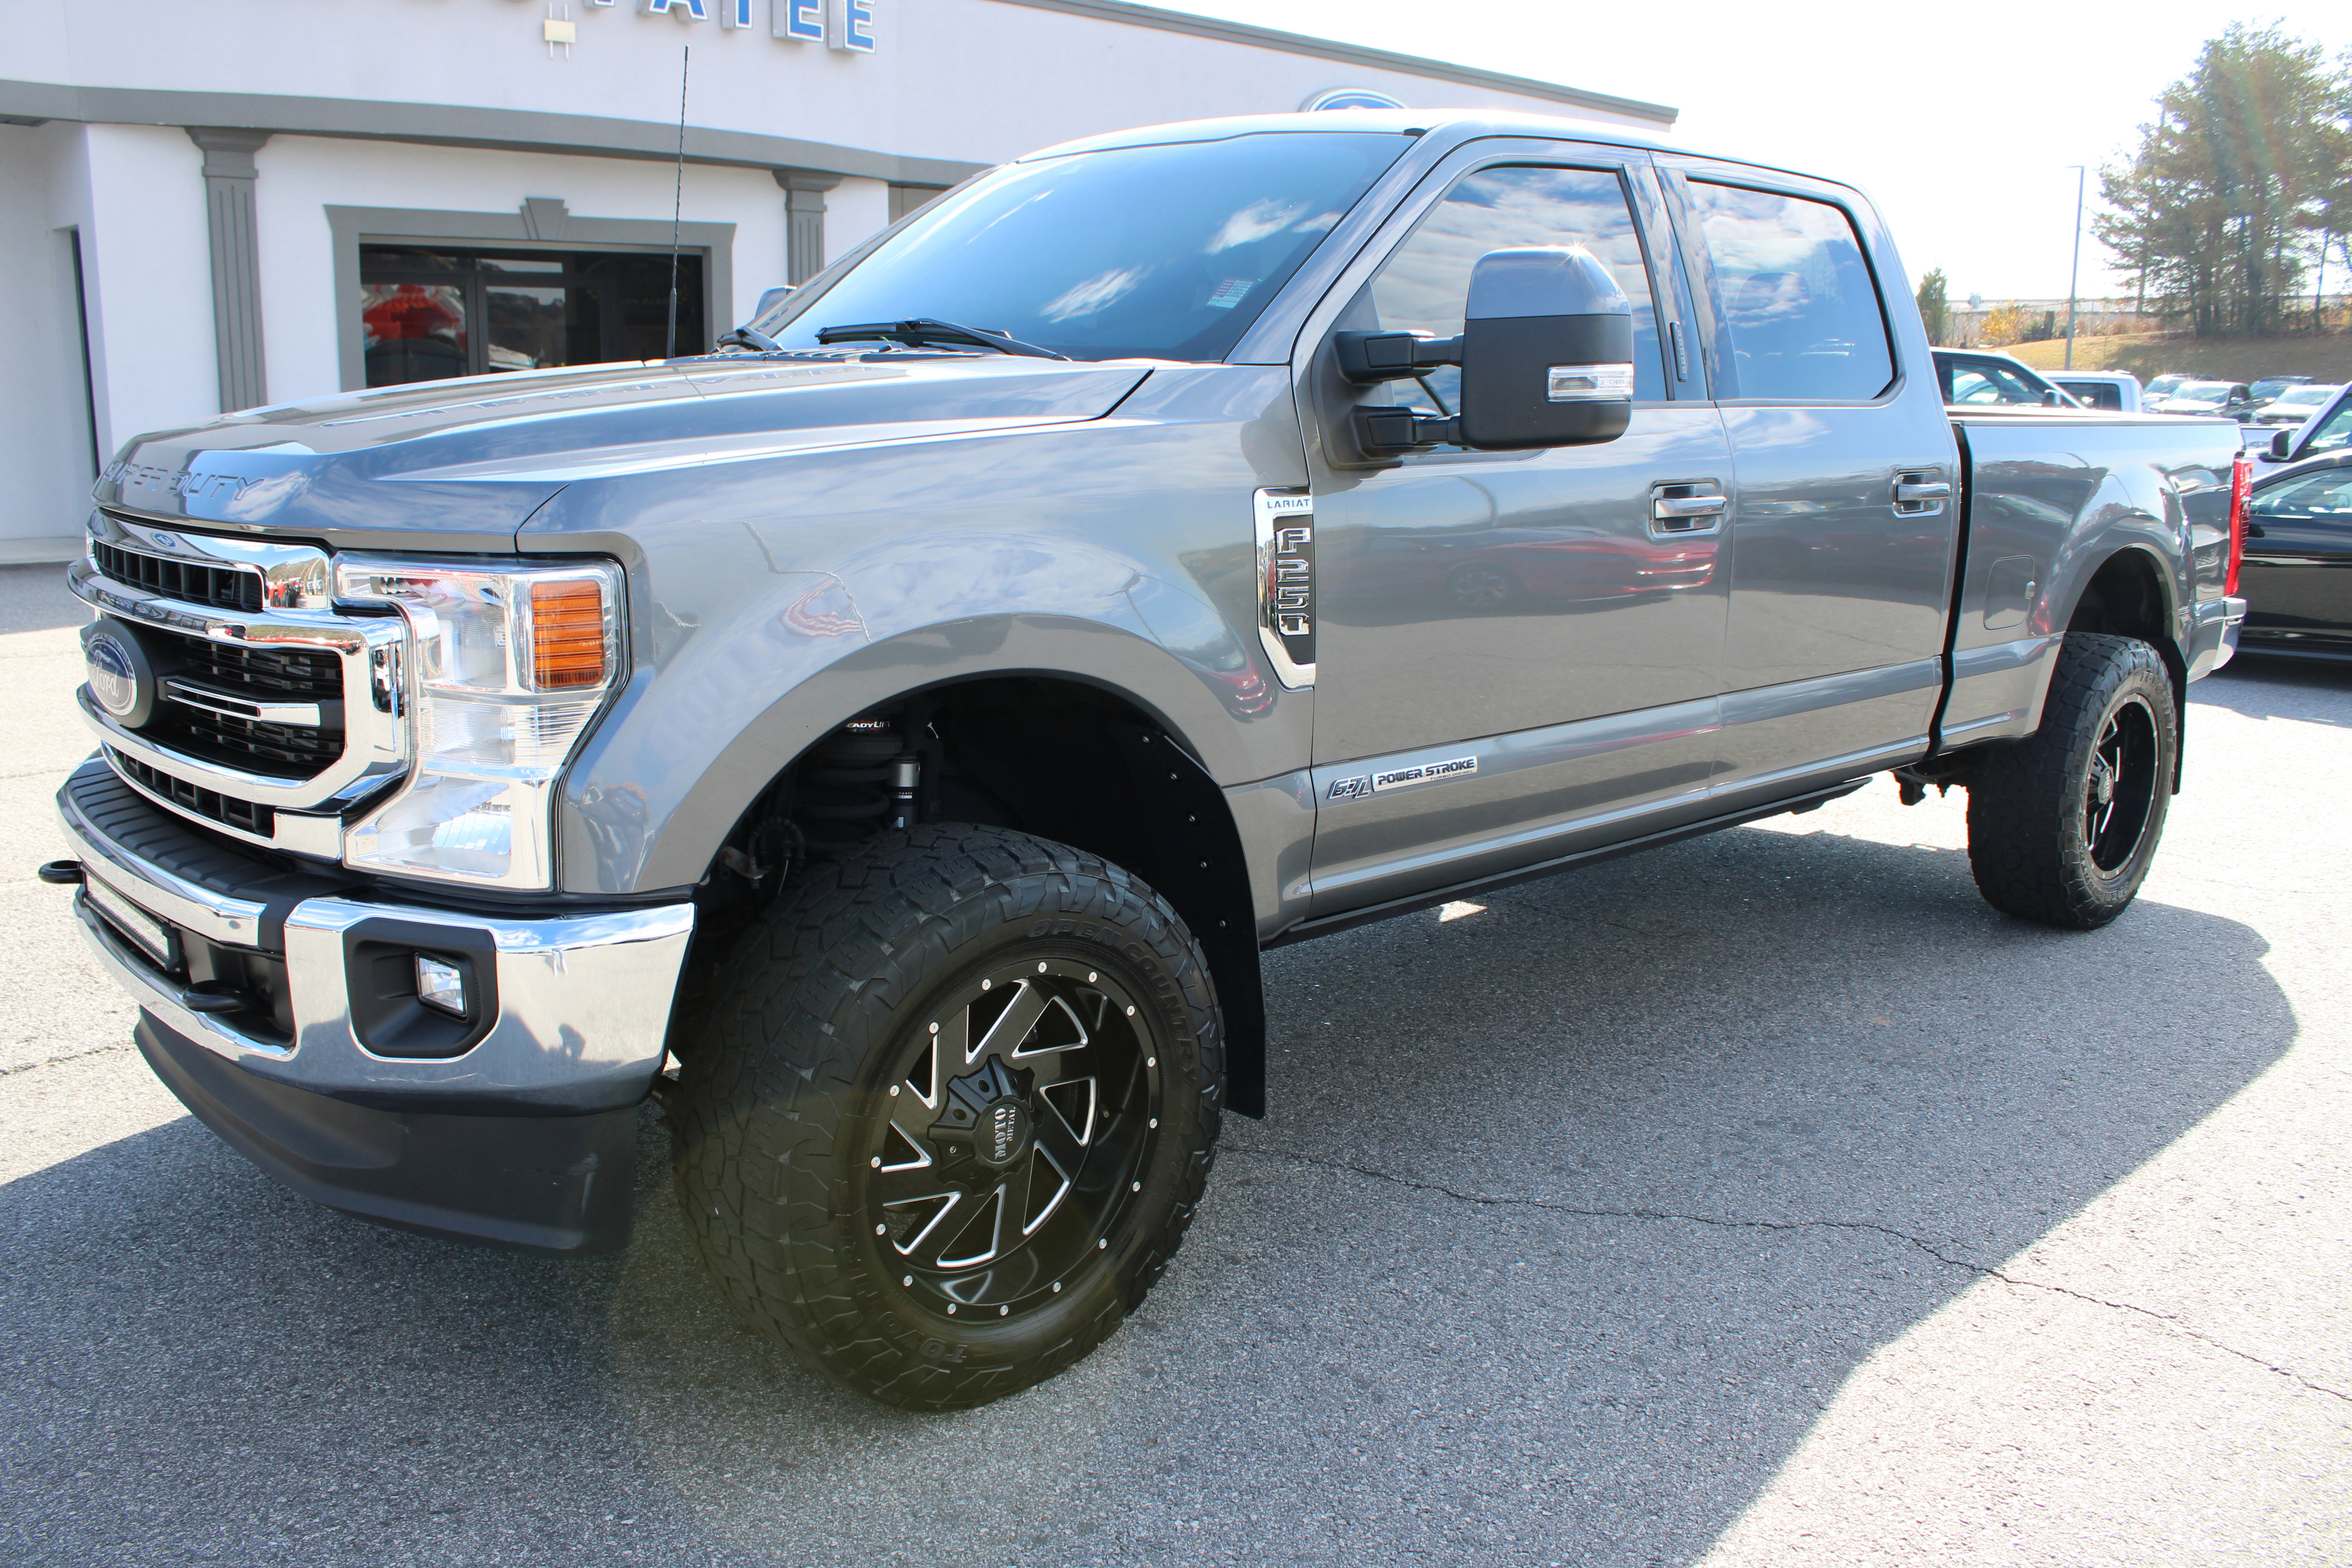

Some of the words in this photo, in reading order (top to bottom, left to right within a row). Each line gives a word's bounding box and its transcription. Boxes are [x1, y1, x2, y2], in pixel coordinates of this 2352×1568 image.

[162, 470, 265, 501] DUTY
[1267, 499, 1310, 509] LARIAT
[92, 649, 119, 698] Ford
[1378, 768, 1423, 786] POWER
[1425, 759, 1475, 776] STROKE
[1028, 918, 1123, 948] OPEN
[1120, 942, 1197, 1091] COUNTRY
[994, 1108, 1006, 1160] MOTO
[1006, 1107, 1016, 1142] METAL
[877, 1311, 968, 1363] TOYO
